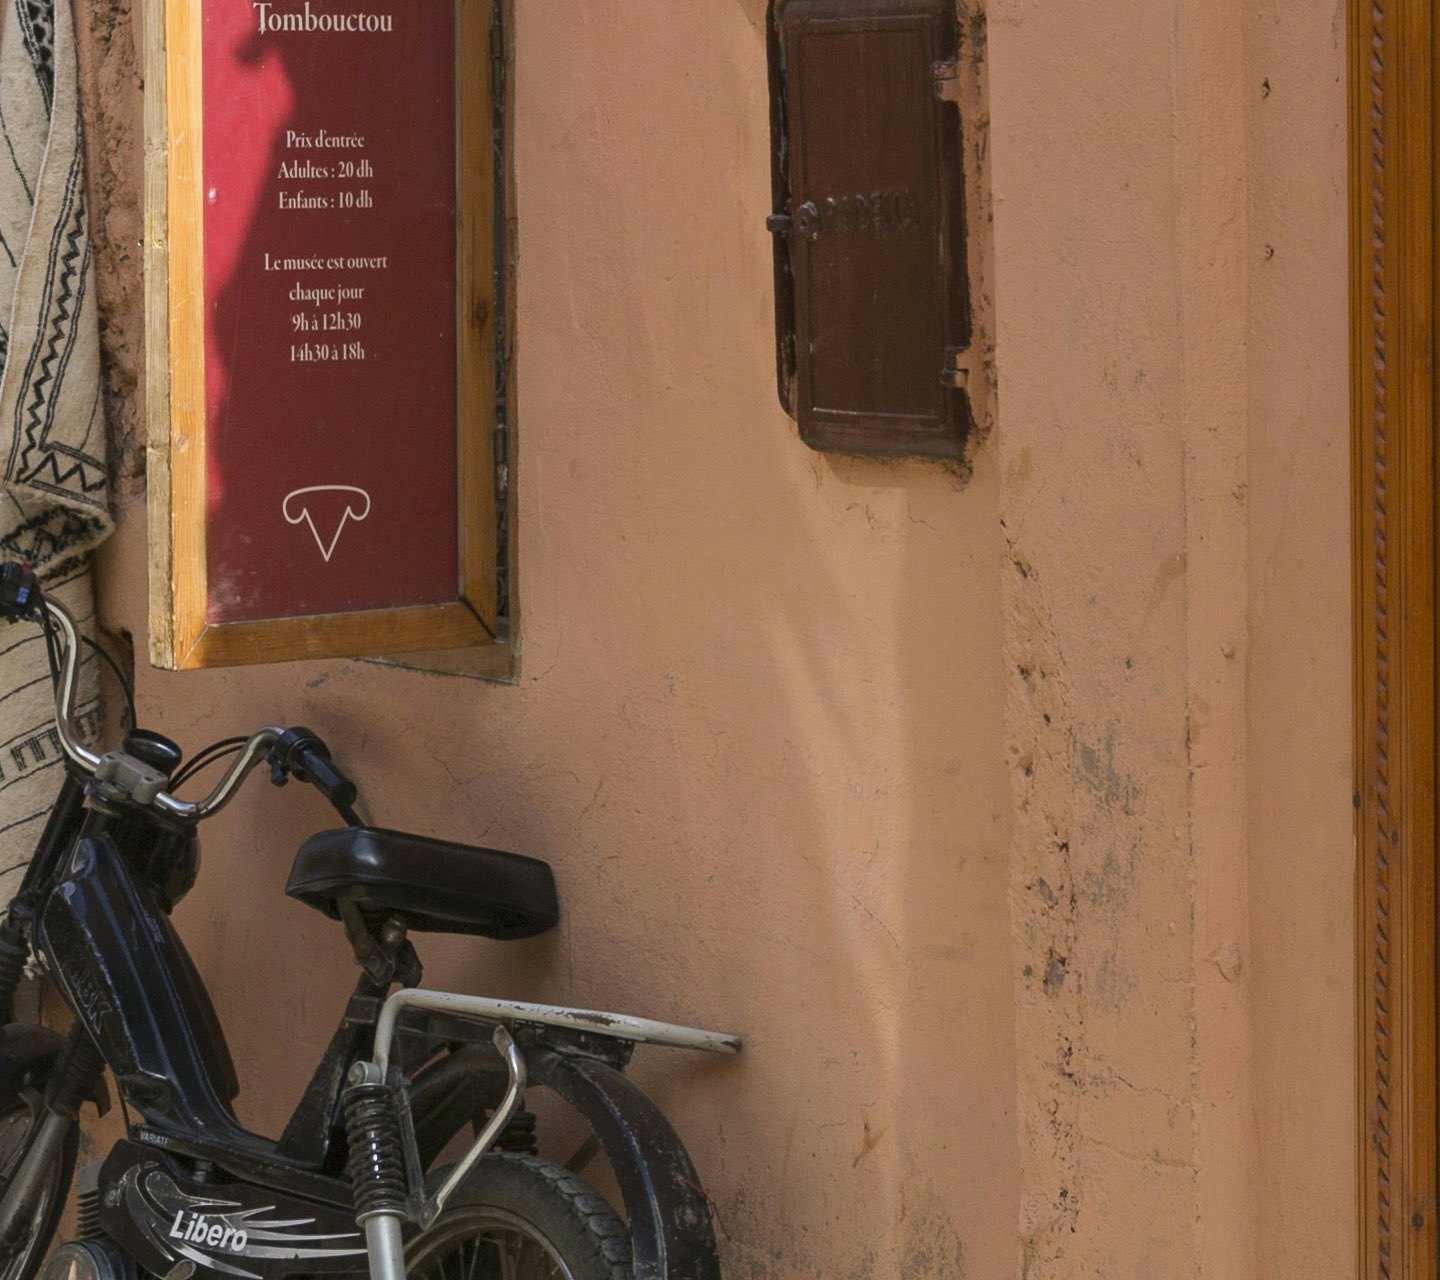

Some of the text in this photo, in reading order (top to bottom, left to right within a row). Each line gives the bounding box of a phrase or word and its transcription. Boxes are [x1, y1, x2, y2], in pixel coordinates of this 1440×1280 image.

[253, 1, 394, 33] Tombouctou
[286, 128, 366, 149] Prix d'entrée
[277, 159, 329, 179] Adultes
[337, 160, 354, 179] 20
[356, 159, 374, 178] dh
[278, 189, 329, 210] Enfants
[338, 191, 354, 209] 10
[356, 189, 374, 209] dh
[264, 252, 389, 271] Le musée est ouvert
[288, 281, 366, 307] chaque jour
[292, 311, 362, 333] 9h à 12h30
[290, 341, 366, 362] 14h30 à 18h
[169, 1209, 249, 1252] Libero
